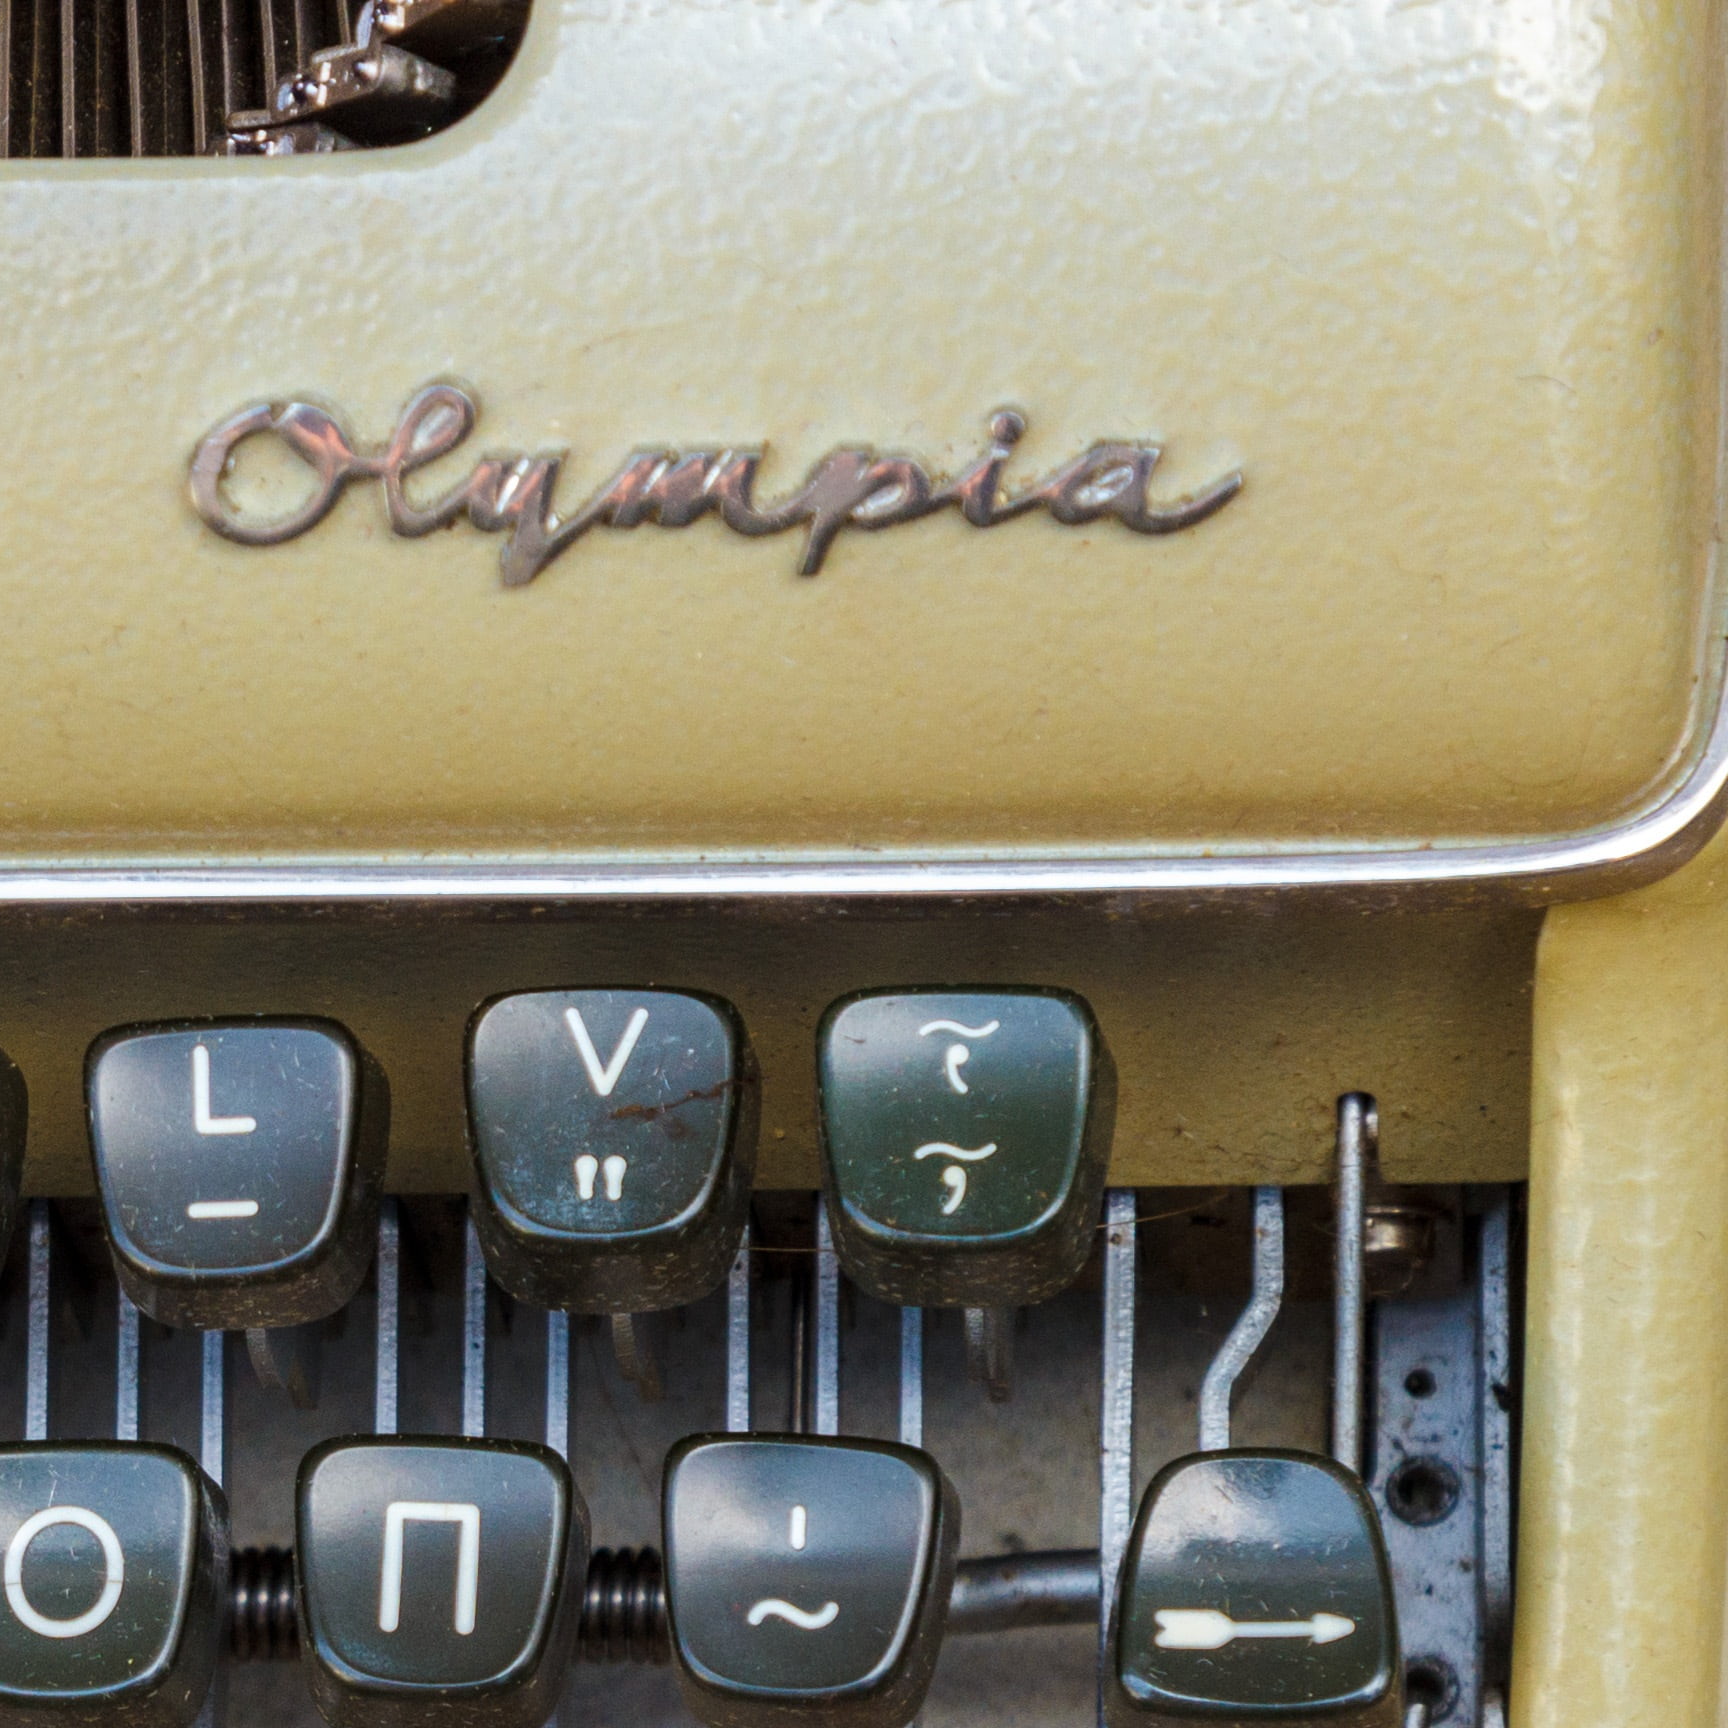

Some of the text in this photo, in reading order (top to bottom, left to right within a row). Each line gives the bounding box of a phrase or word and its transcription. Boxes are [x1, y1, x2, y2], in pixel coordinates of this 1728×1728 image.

[186, 375, 1244, 588] Olympia
[192, 1044, 258, 1136] L
[563, 1006, 650, 1097] V
[379, 1500, 481, 1635] Π
